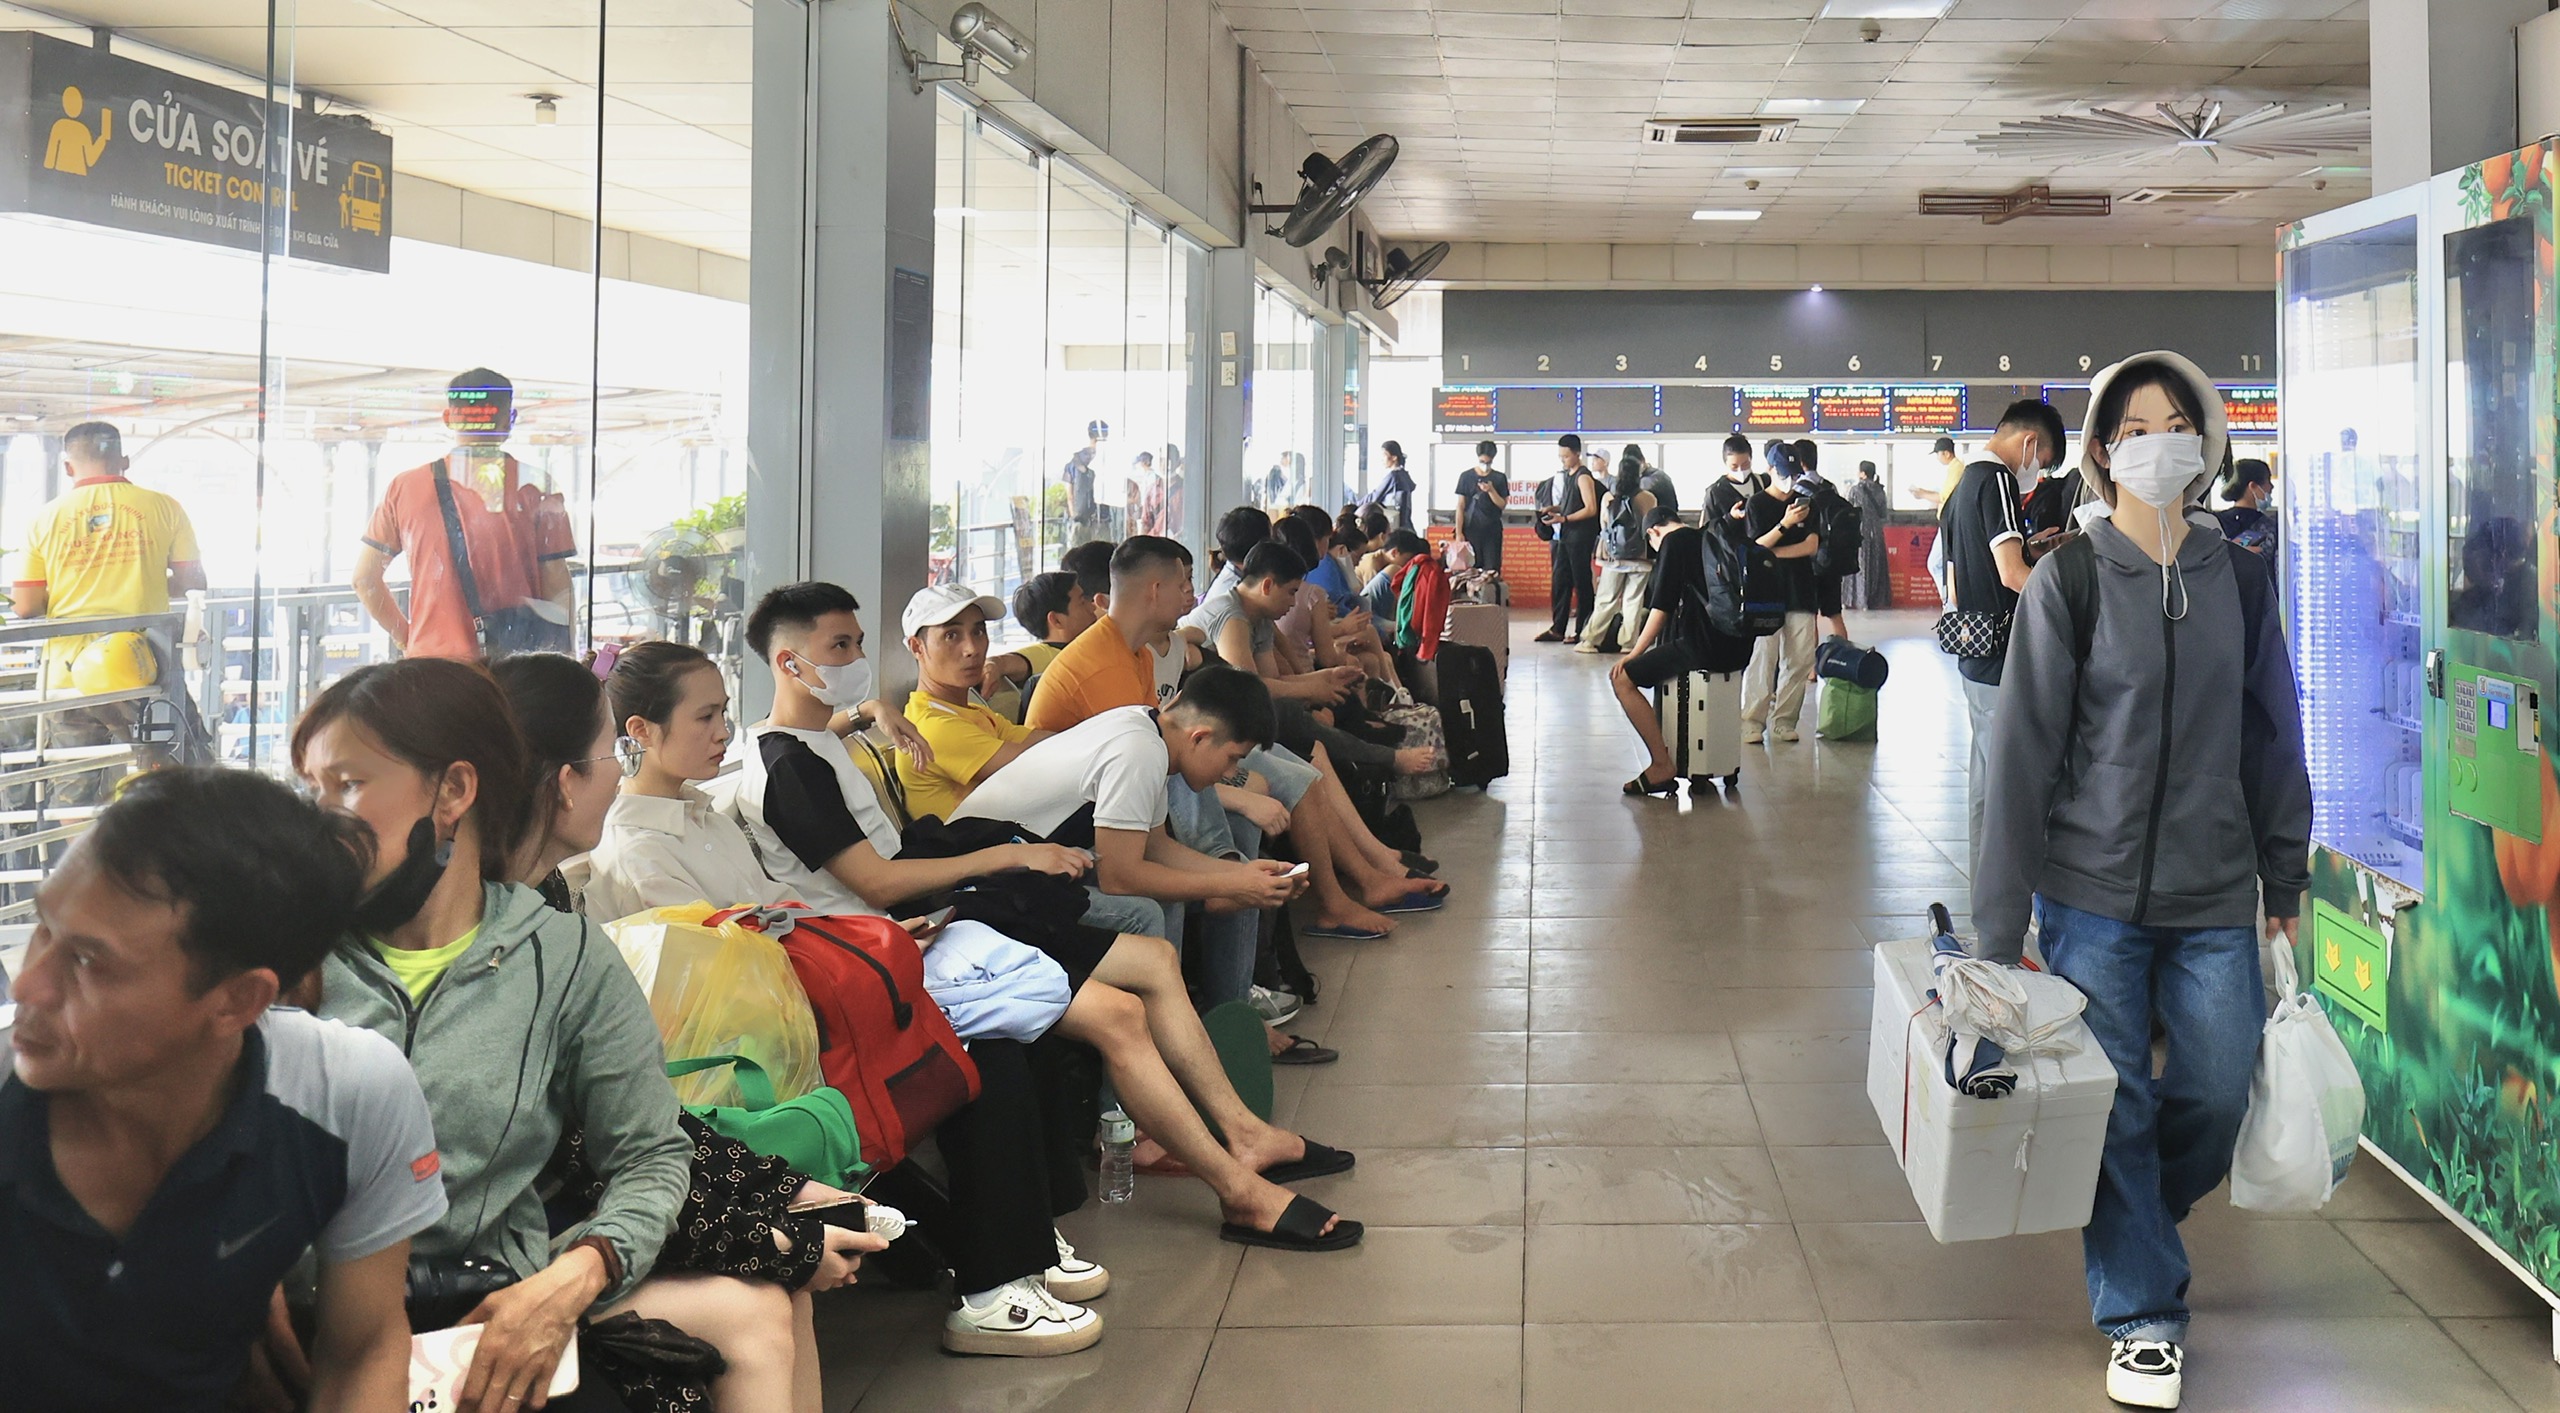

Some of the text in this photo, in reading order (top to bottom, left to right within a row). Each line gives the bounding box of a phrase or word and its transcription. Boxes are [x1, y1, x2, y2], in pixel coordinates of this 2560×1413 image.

[128, 90, 202, 156] CỬA
[296, 136, 328, 185] VÉ
[164, 162, 299, 212] TICKET CONRL
[111, 192, 137, 211] HÀNH
[139, 199, 171, 217] KHÁCH
[173, 206, 188, 221] VUI
[189, 207, 214, 226] LÒNG
[215, 211, 238, 231] XUẤT
[238, 216, 261, 234] TRÌNH
[292, 230, 306, 243] KHI
[323, 232, 339, 249] CỬA
[1461, 355, 2261, 371] 1 2 3 4 5 6 7 8 9 11
